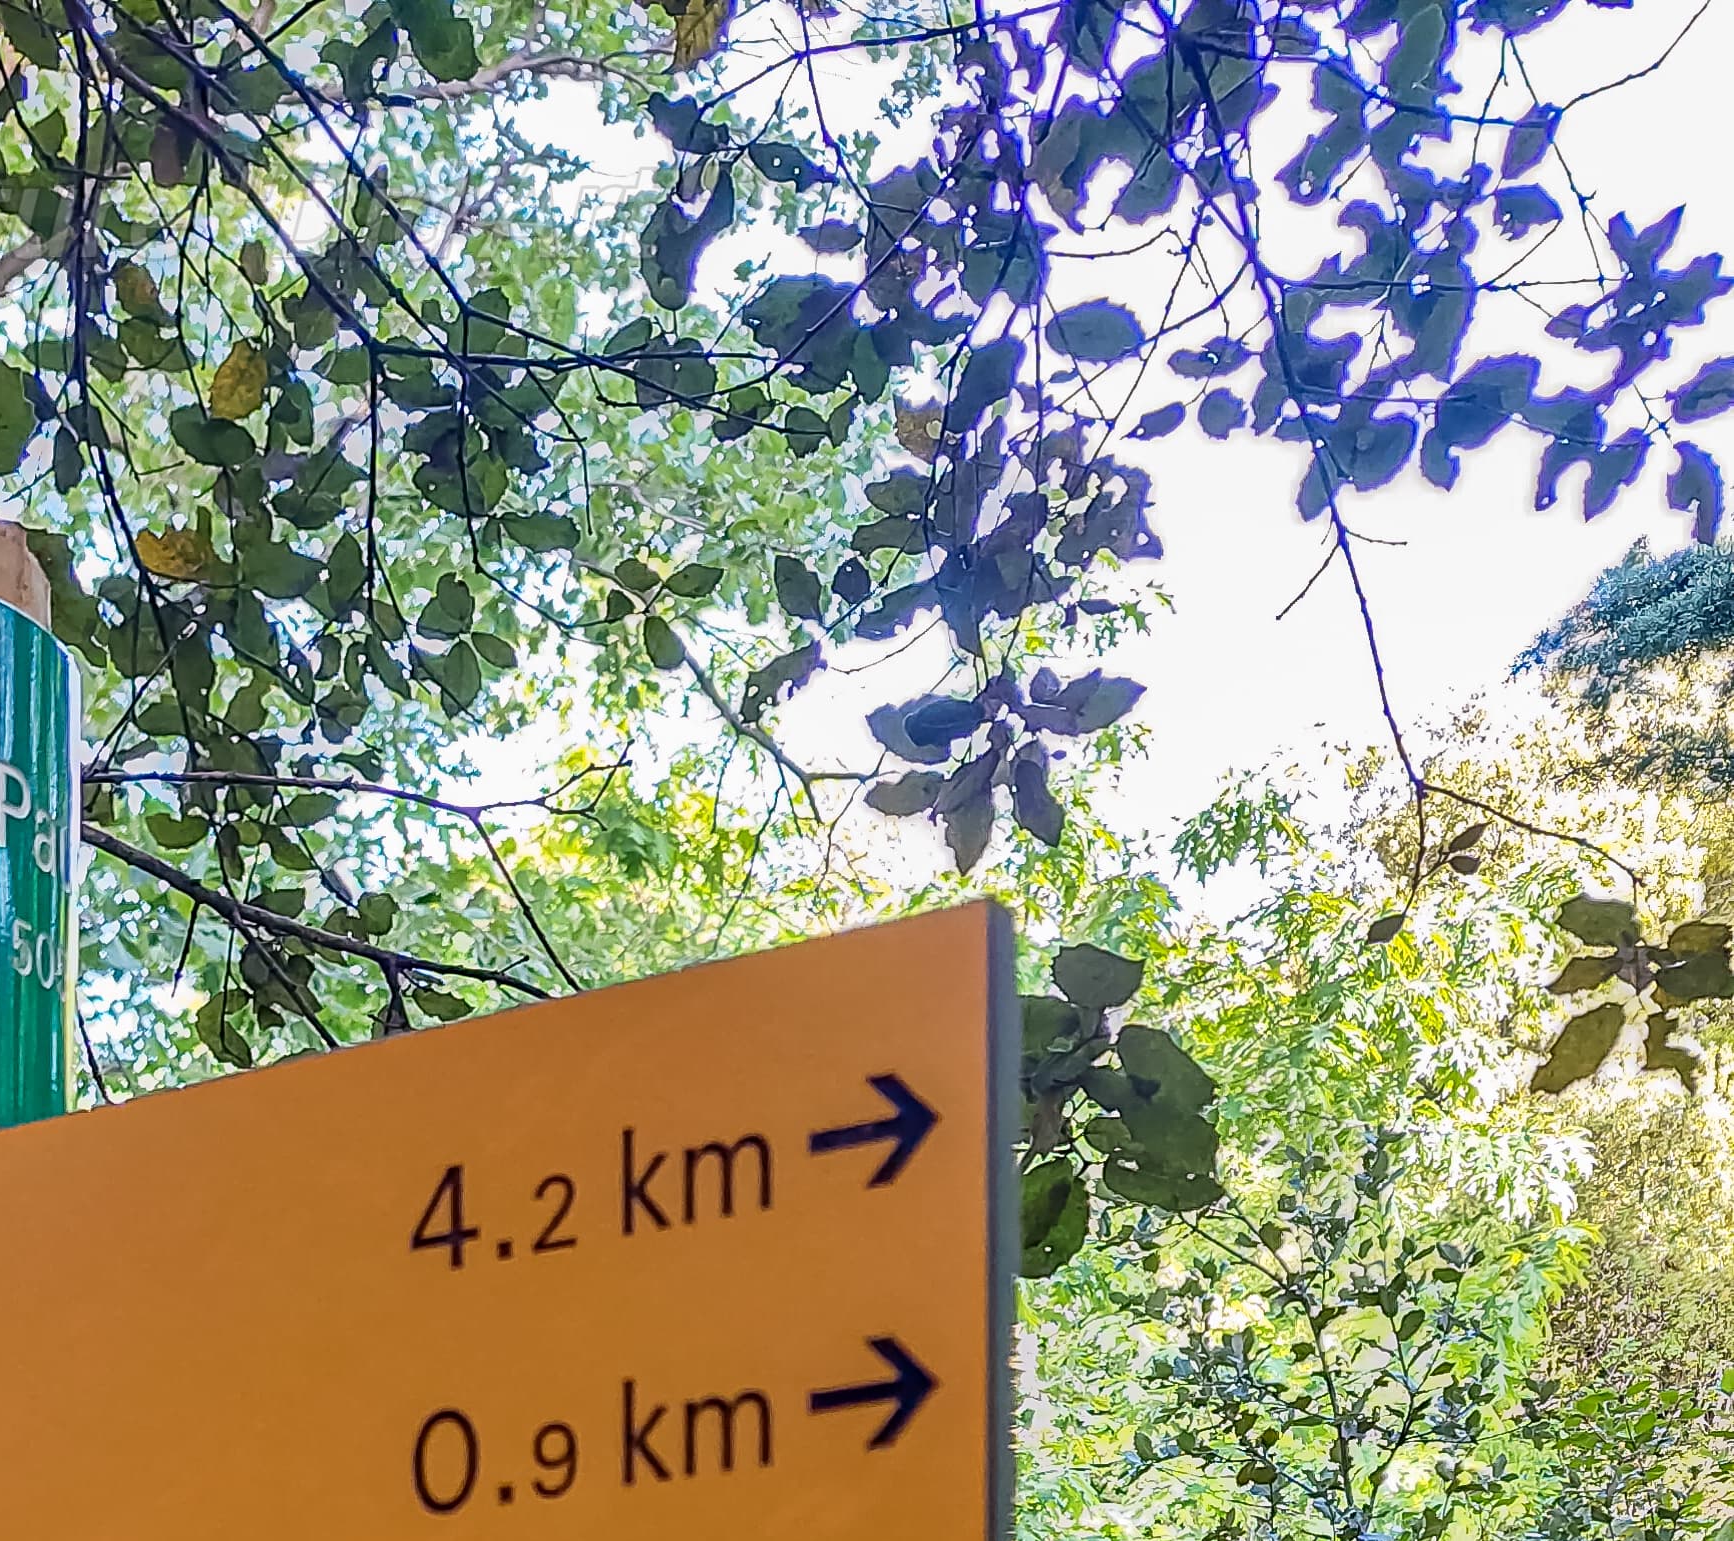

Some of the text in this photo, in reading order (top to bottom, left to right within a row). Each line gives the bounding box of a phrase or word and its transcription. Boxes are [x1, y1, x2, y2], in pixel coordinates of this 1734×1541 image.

[409, 1126, 774, 1270] 4.2 km
[411, 1377, 775, 1516] 0.9 km
